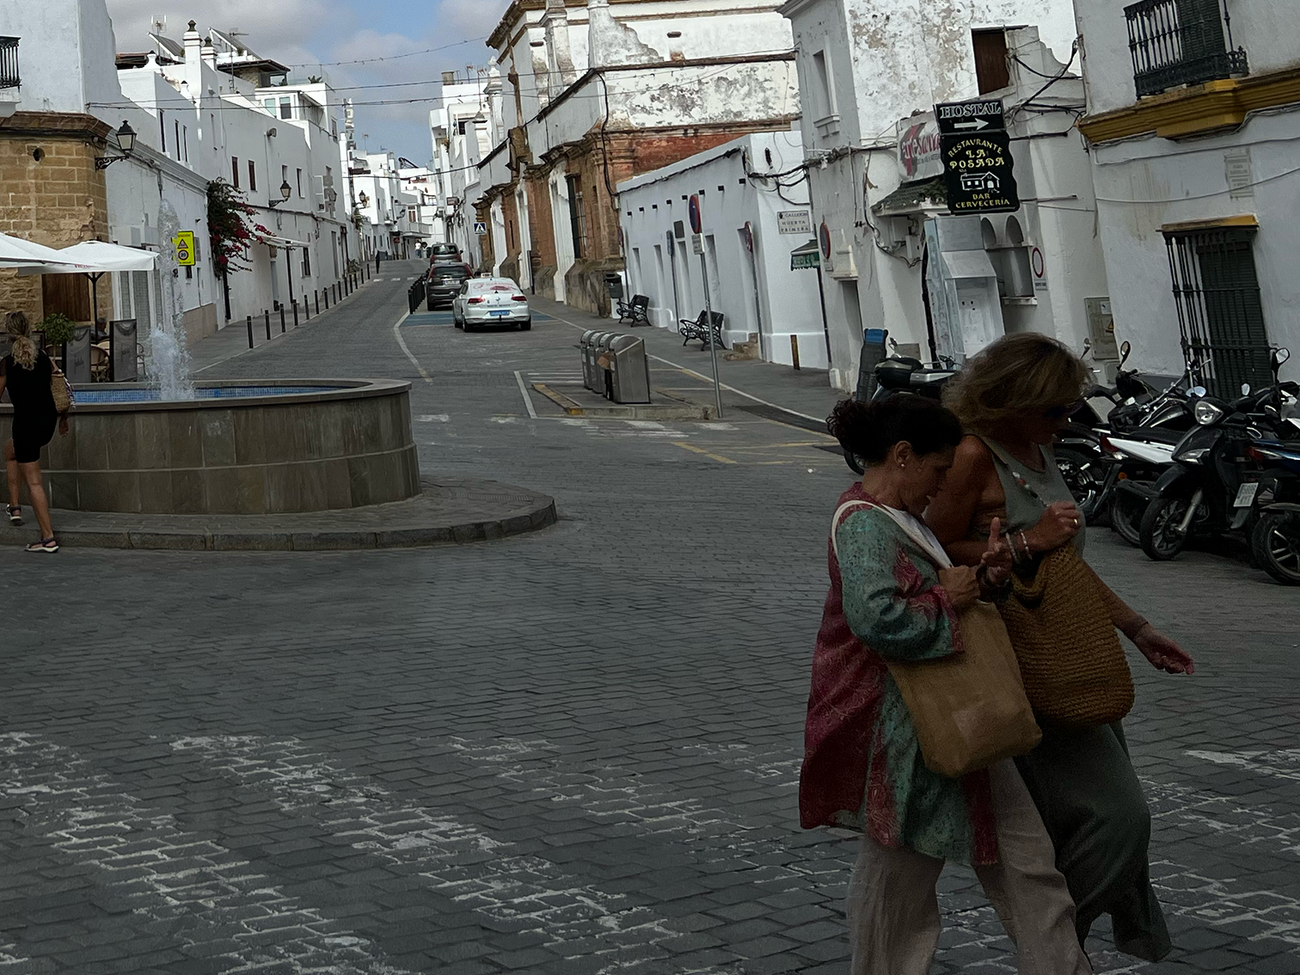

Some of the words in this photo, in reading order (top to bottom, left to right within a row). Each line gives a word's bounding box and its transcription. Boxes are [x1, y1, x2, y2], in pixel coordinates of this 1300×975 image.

[939, 102, 1001, 119] HOSTAL
[966, 149, 986, 159] LA
[949, 157, 1005, 169] POSADA
[972, 192, 990, 200] BAR
